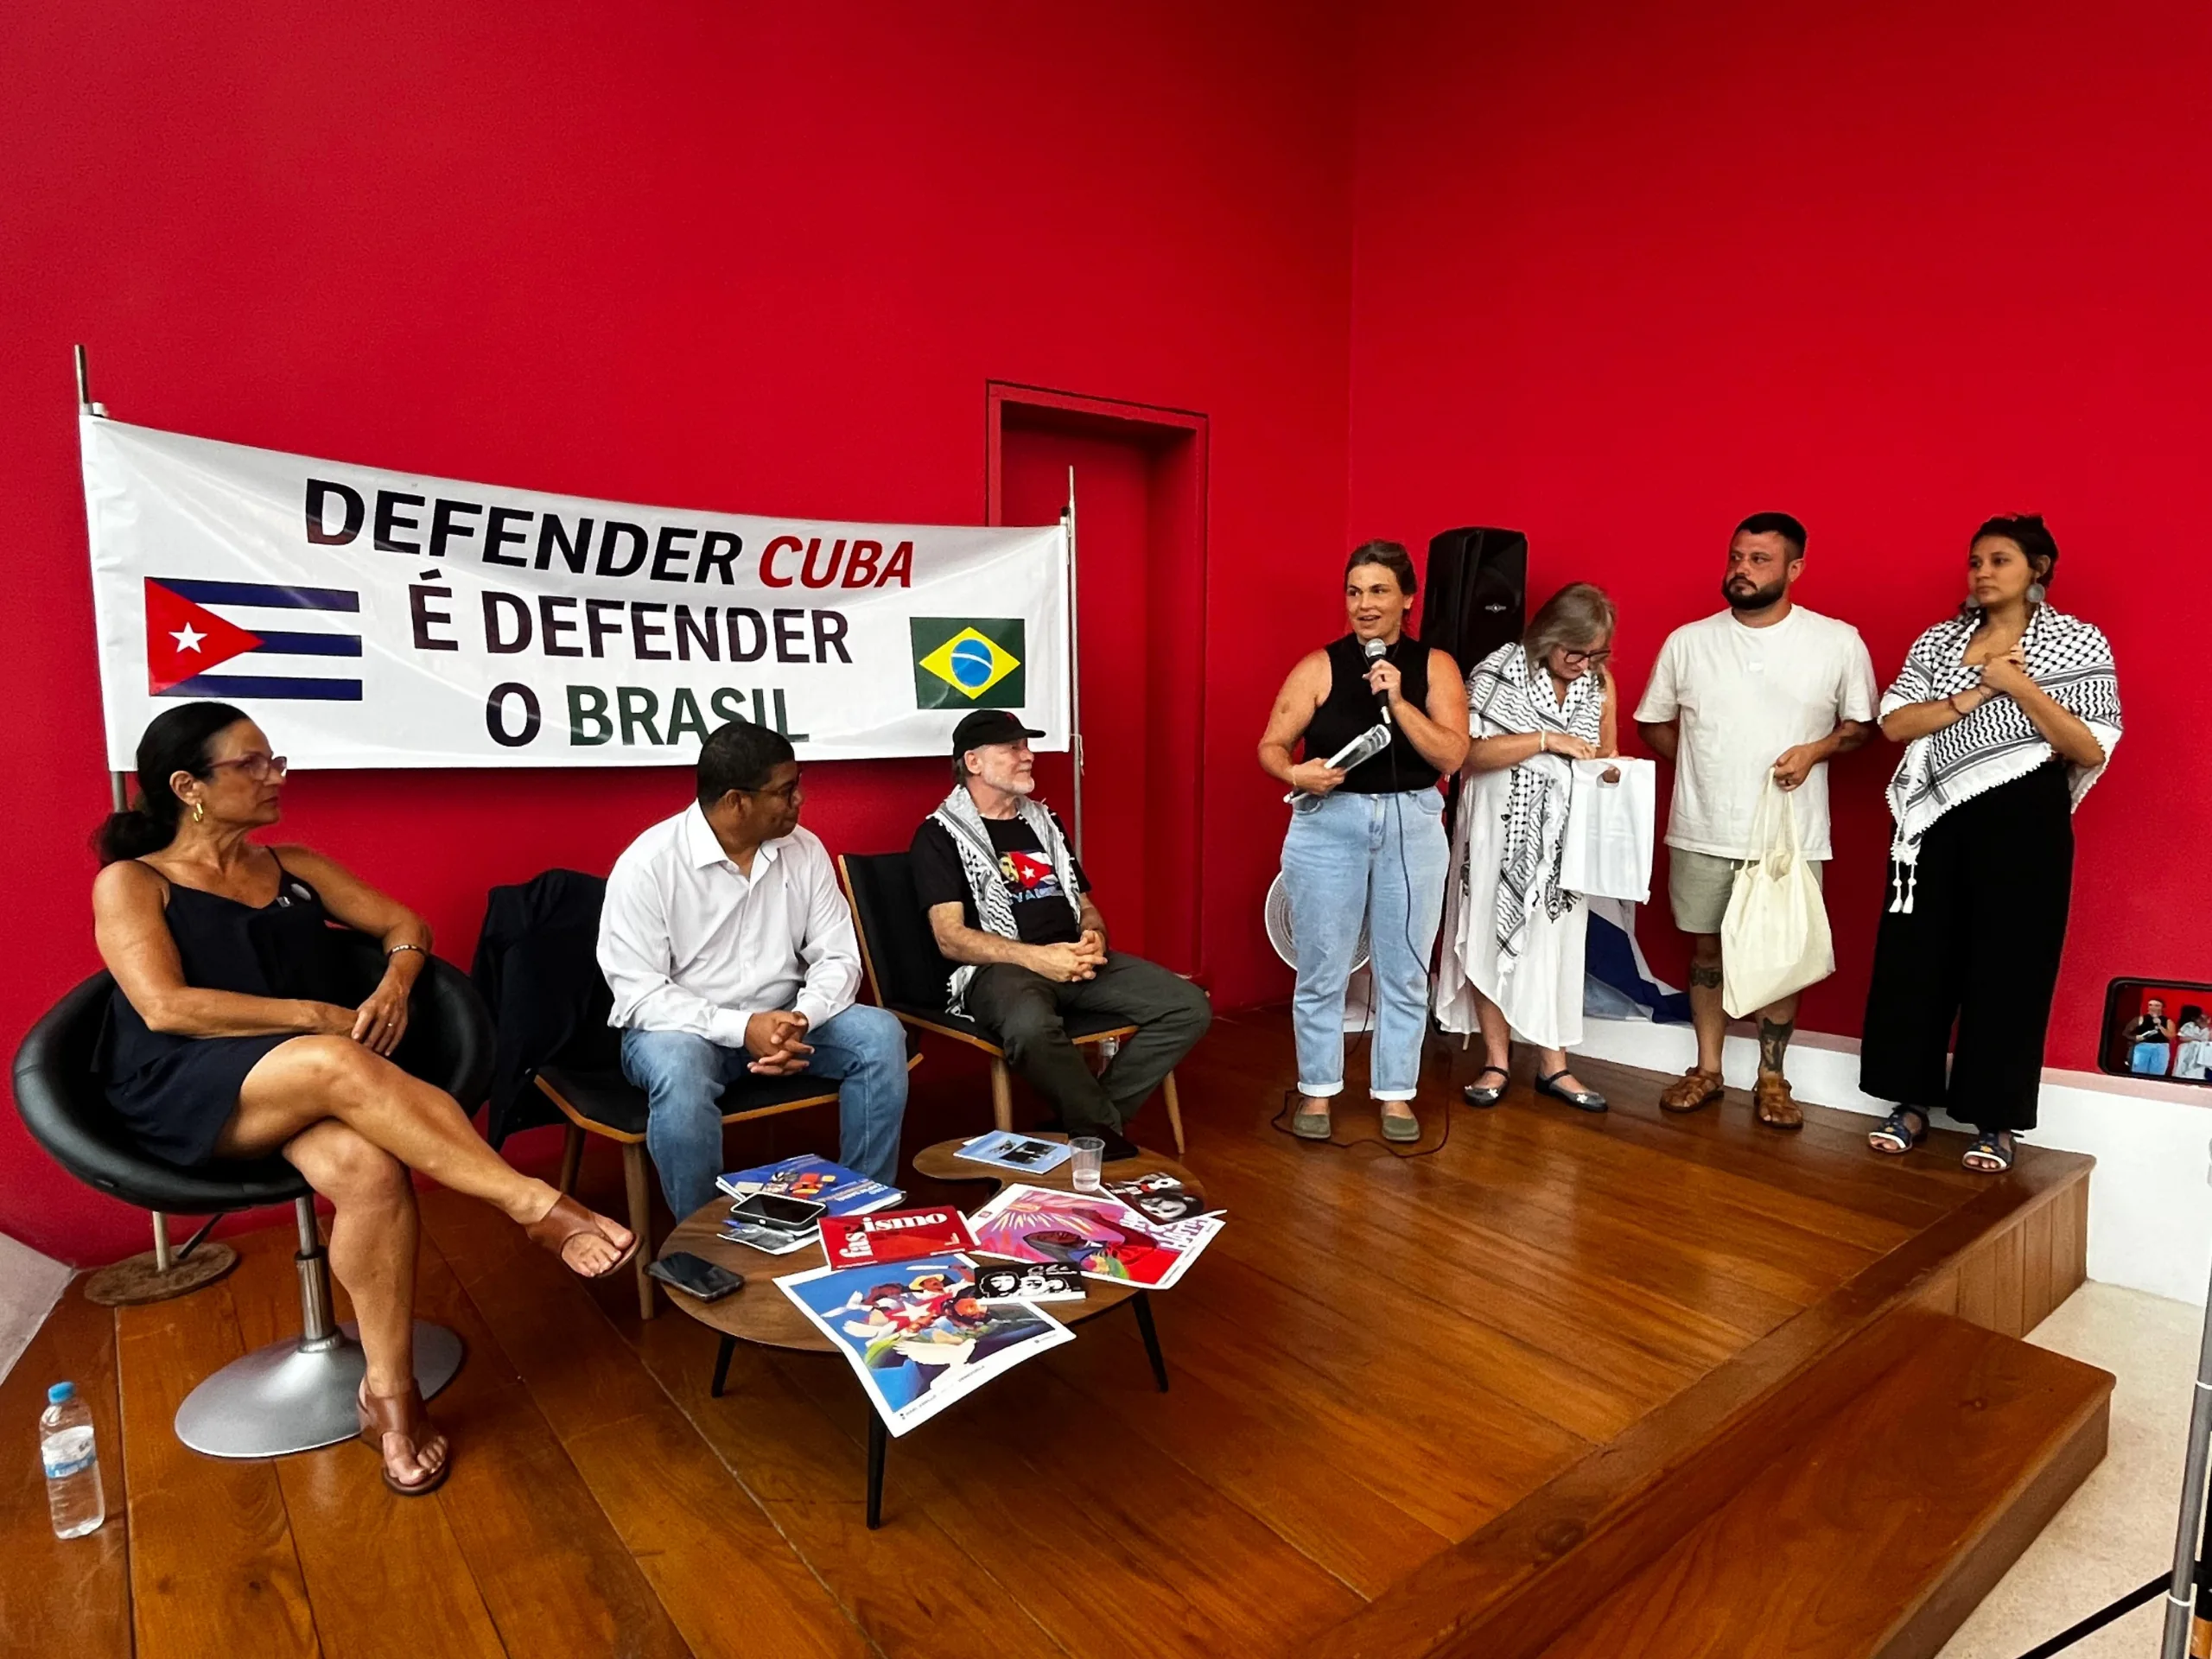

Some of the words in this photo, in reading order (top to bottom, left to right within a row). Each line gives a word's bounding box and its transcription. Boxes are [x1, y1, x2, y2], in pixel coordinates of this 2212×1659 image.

[305, 478, 743, 586] DEFENDER
[759, 535, 914, 588] CUBA
[408, 568, 459, 652] É
[480, 590, 854, 664] DEFENDER
[486, 682, 542, 747] O
[566, 684, 810, 747] BRASIL
